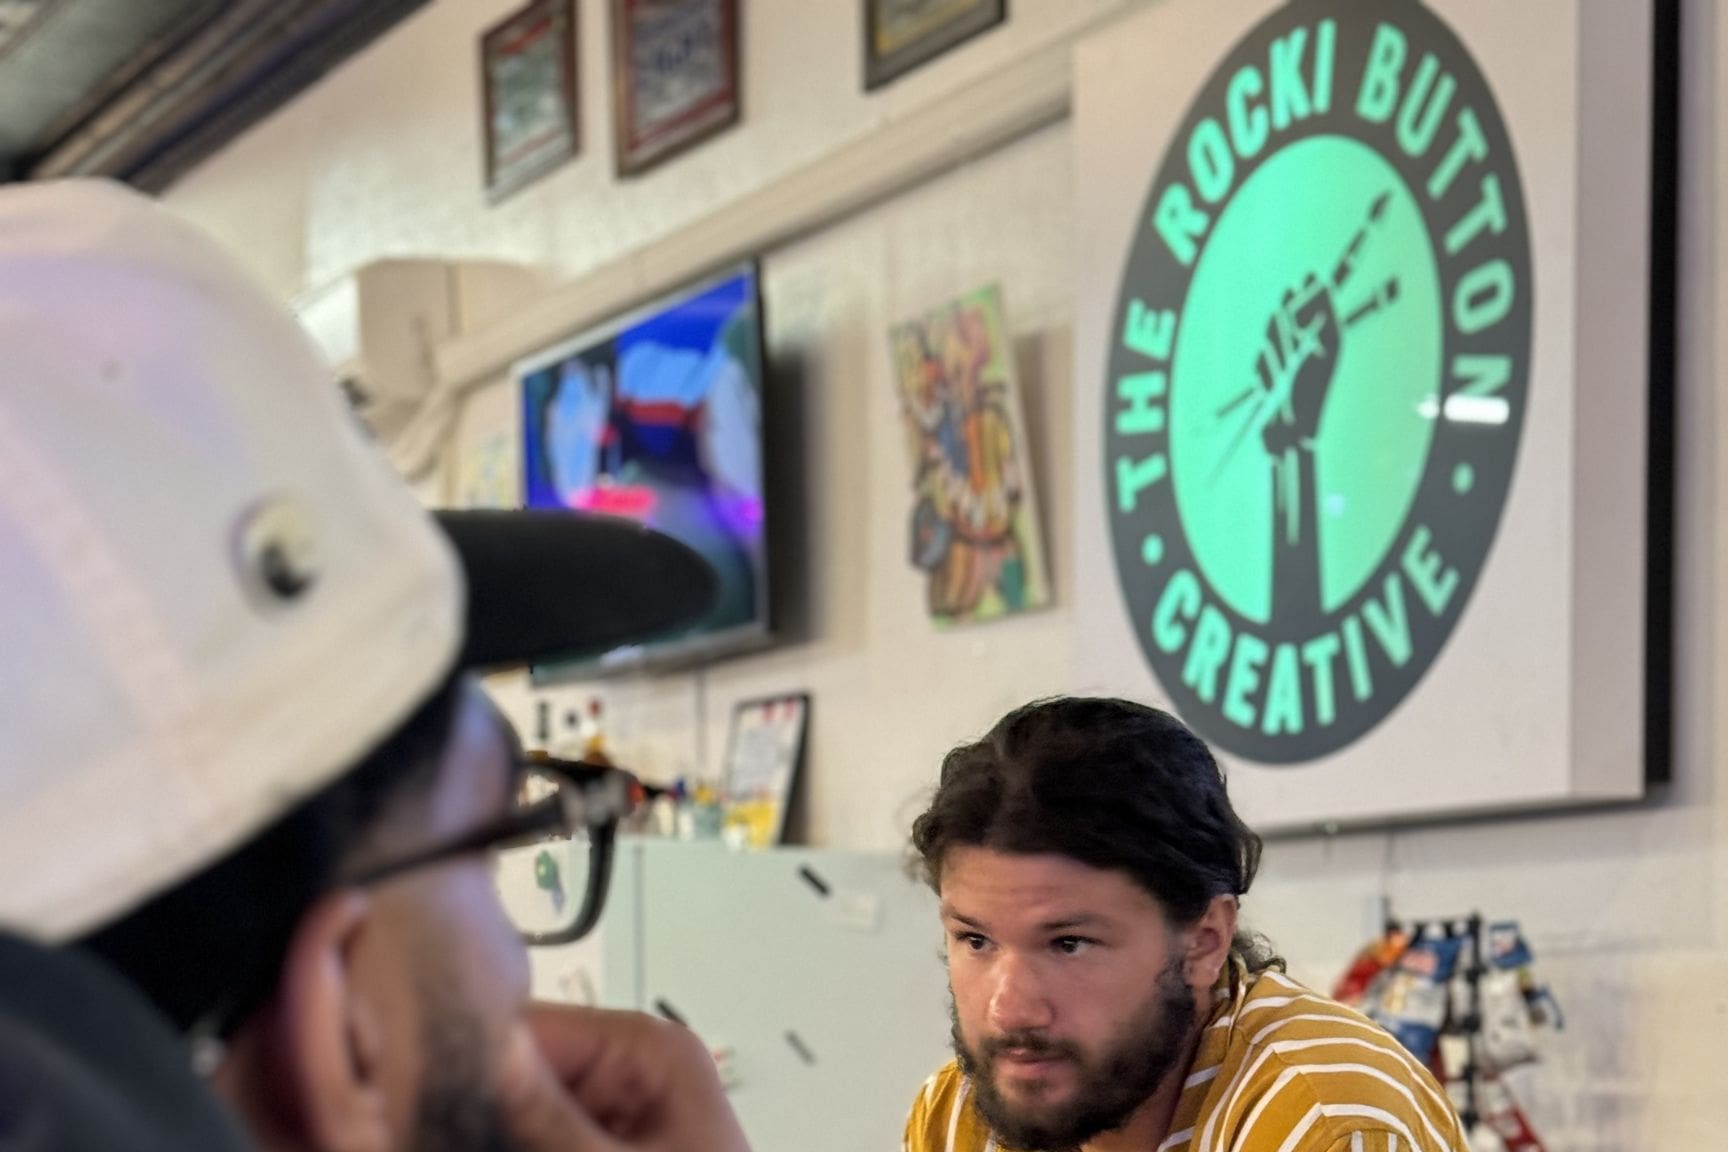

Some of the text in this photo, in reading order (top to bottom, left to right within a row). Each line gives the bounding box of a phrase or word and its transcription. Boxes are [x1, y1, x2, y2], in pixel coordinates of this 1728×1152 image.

[1116, 19, 1515, 511] THE ROCKI BUTTON
[1151, 526, 1459, 734] CREATIVE
